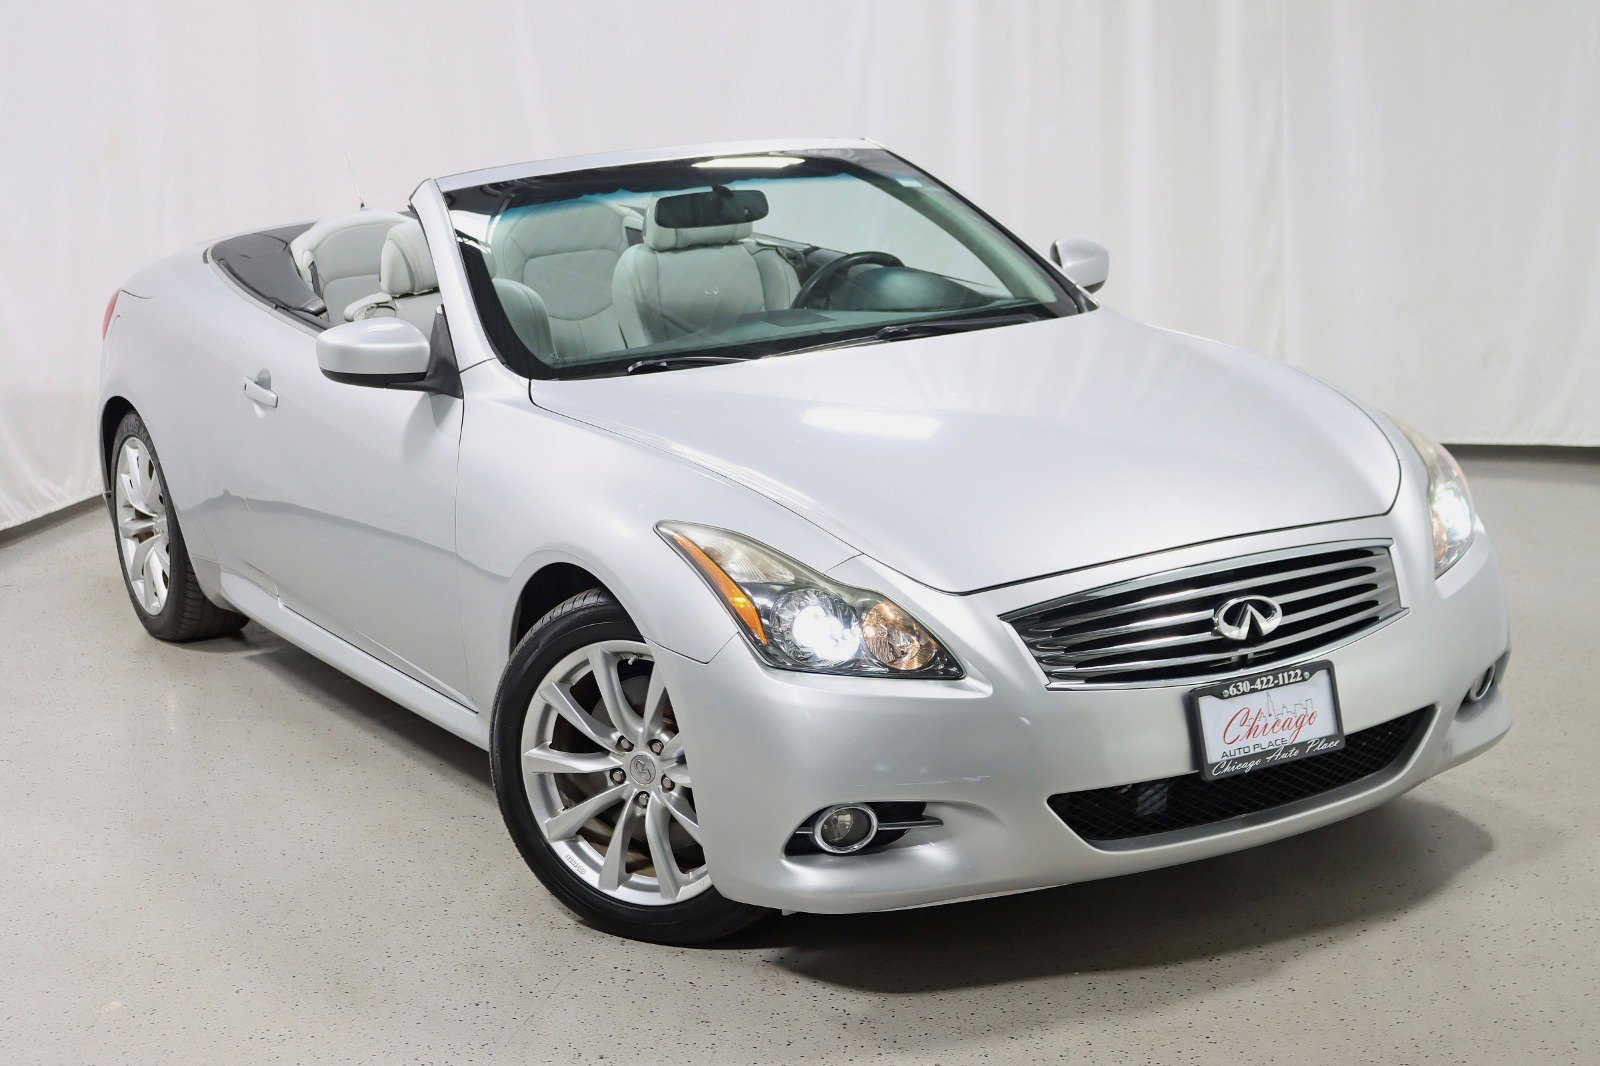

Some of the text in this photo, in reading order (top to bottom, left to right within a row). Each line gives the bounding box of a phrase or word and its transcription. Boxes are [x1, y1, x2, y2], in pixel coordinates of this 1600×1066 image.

[1229, 669, 1303, 696] 630-422-1122
[1223, 706, 1318, 745] Chicago
[1212, 737, 1340, 776] Chicago Auto Place
[1221, 737, 1288, 759] AUTO PLACE
